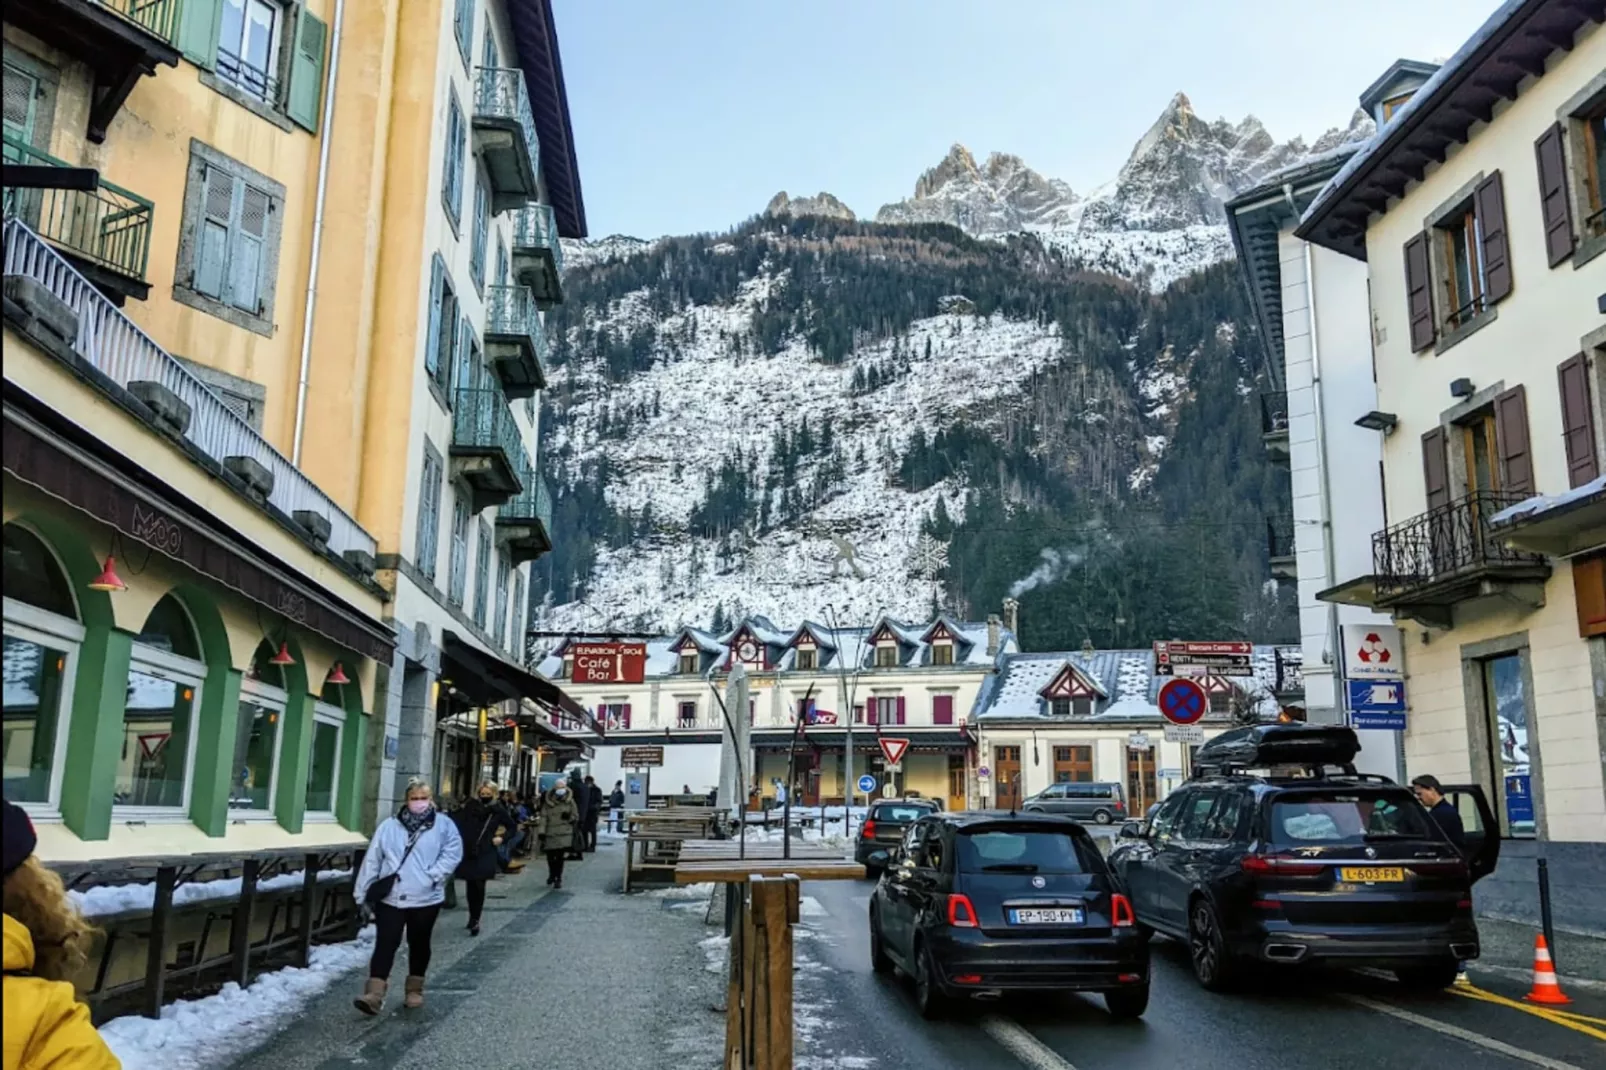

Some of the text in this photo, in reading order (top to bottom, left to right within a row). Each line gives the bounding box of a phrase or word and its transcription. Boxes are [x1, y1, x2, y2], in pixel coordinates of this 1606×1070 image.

[131, 503, 182, 555] MOO
[623, 648, 643, 656] 1904
[577, 656, 611, 668] Café
[587, 668, 610, 680] Bar
[1346, 867, 1398, 880] L-603-FR
